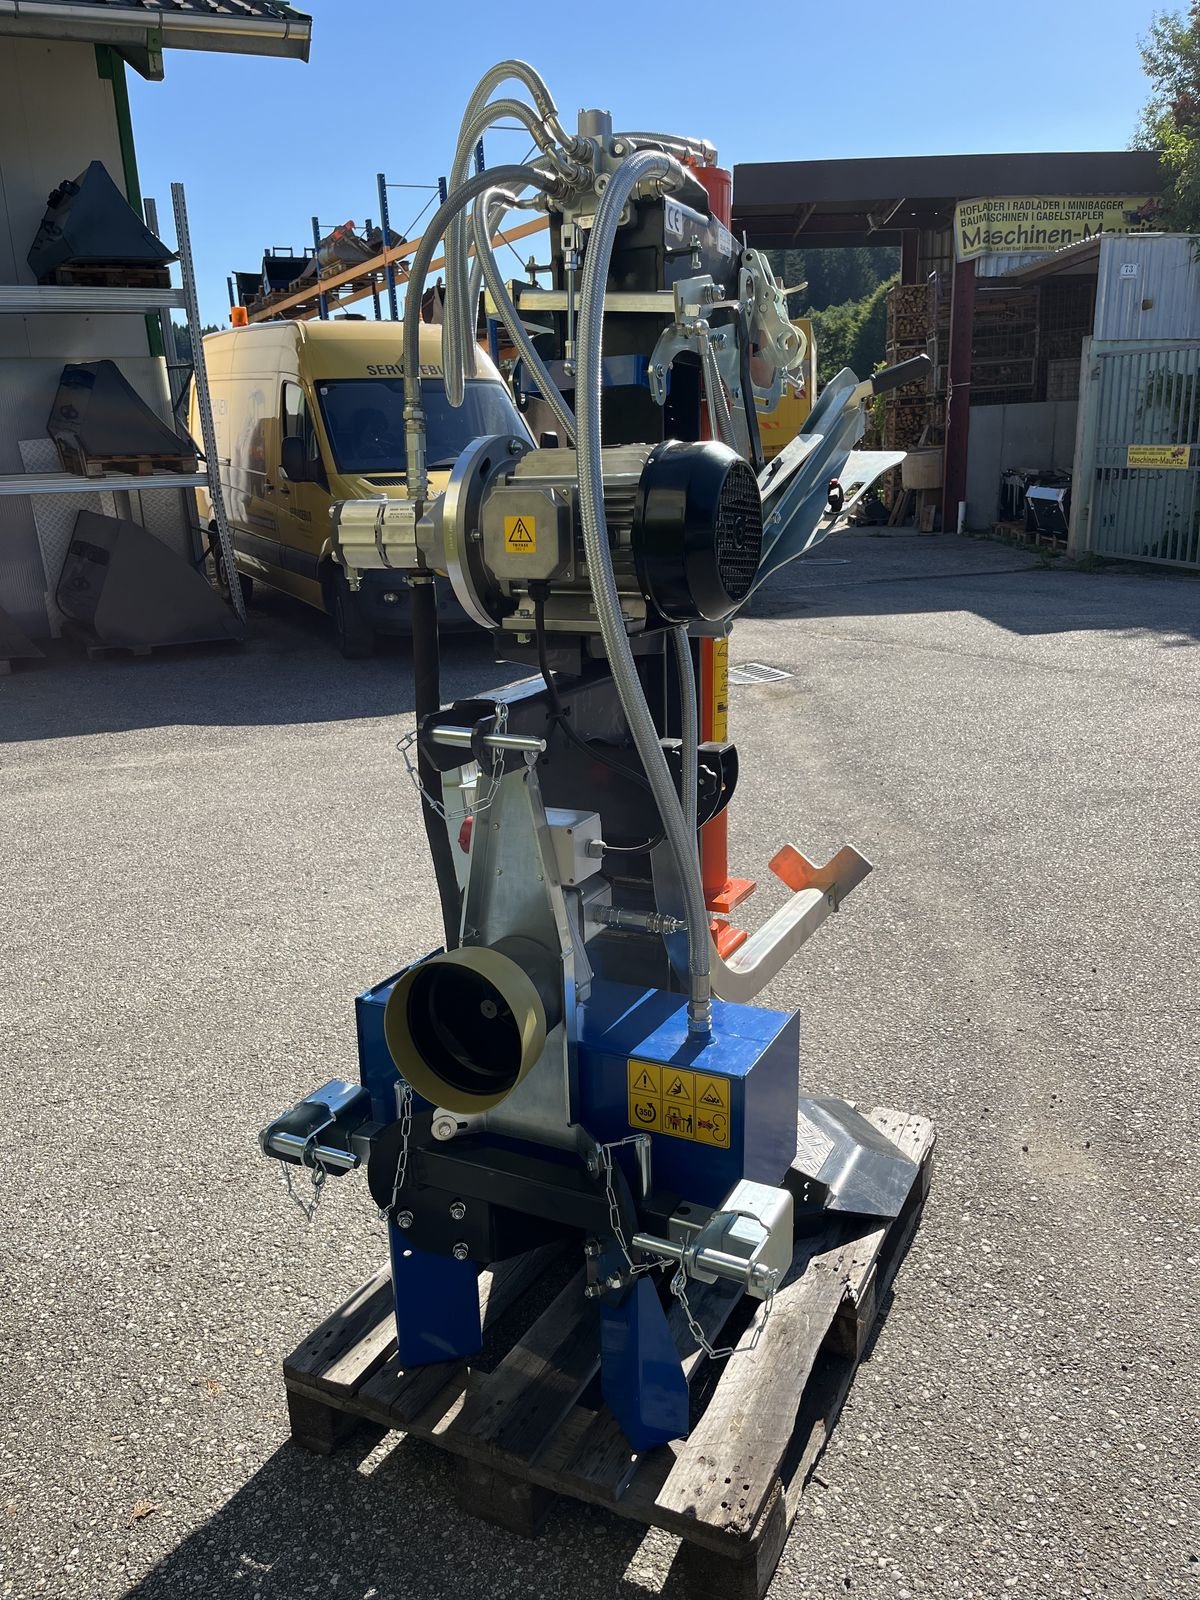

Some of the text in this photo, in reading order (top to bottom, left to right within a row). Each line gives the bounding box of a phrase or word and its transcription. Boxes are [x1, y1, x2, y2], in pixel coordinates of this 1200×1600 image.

[960, 202, 1004, 216] HOFLADER
[1013, 201, 1060, 211] RADLADER
[1068, 201, 1123, 210] MINIBAGGER
[1036, 211, 1104, 221] GABELSTAPLER
[1124, 265, 1134, 273] 73
[639, 1108, 652, 1118] 350
